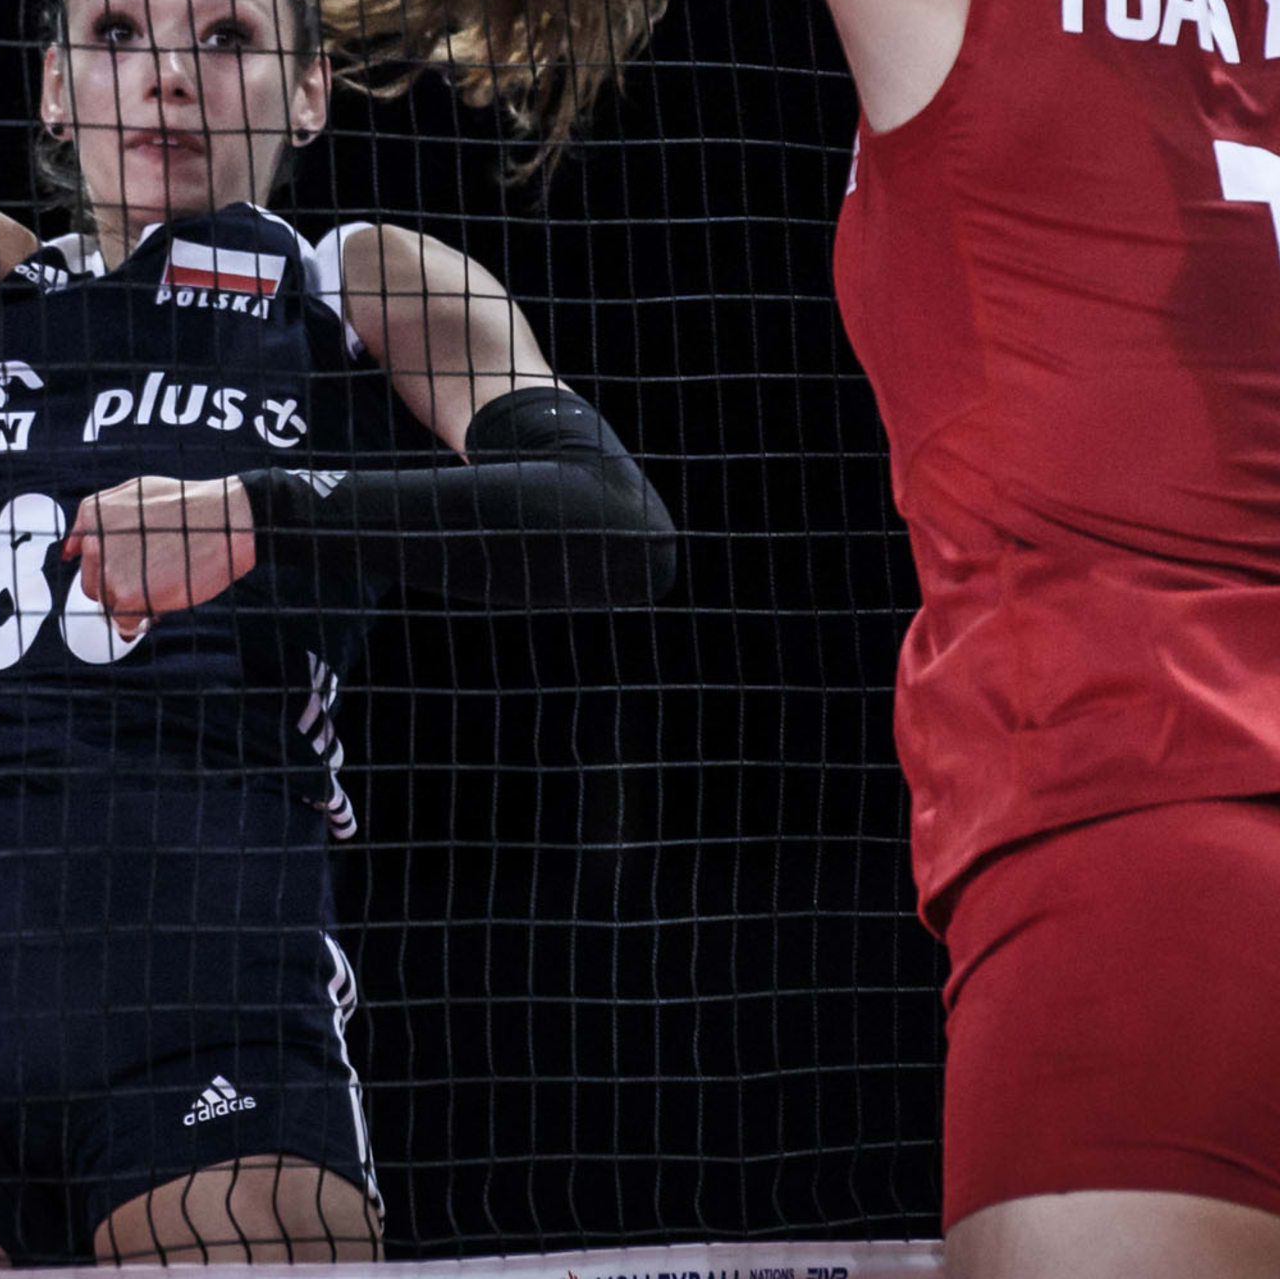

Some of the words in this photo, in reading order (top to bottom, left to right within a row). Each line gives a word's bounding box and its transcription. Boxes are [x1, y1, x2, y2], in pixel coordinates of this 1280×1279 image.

[155, 285, 270, 320] POLSKA
[82, 371, 248, 443] plus
[183, 1096, 257, 1126] adidas
